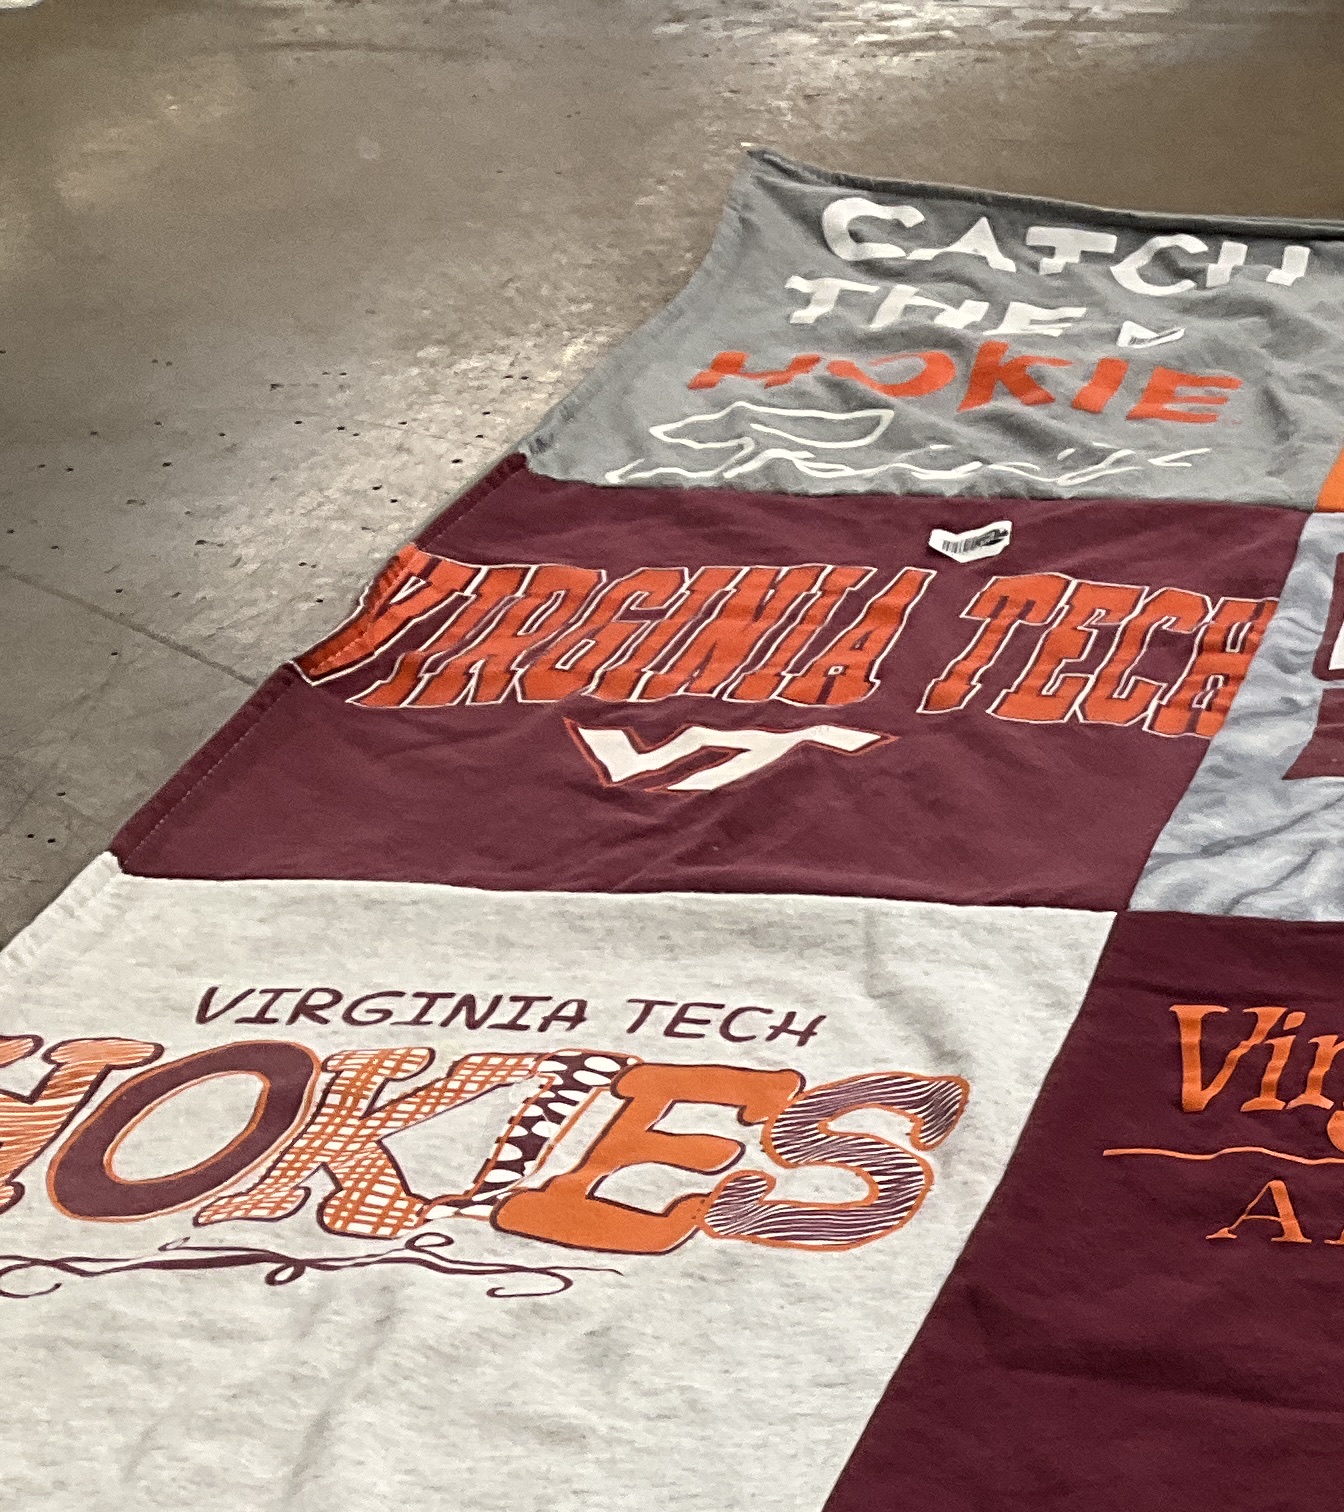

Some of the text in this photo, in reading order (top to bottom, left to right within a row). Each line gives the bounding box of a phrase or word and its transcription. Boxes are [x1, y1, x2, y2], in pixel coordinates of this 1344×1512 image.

[822, 197, 1310, 296] CATCH
[785, 275, 1087, 337] THE
[687, 340, 1243, 422] HOKIE
[288, 543, 1280, 739] VIRGINIA TECH
[563, 717, 900, 796] VT
[193, 985, 828, 1043] VIRGINIA TECH
[0, 1034, 971, 1255] HOKIES
